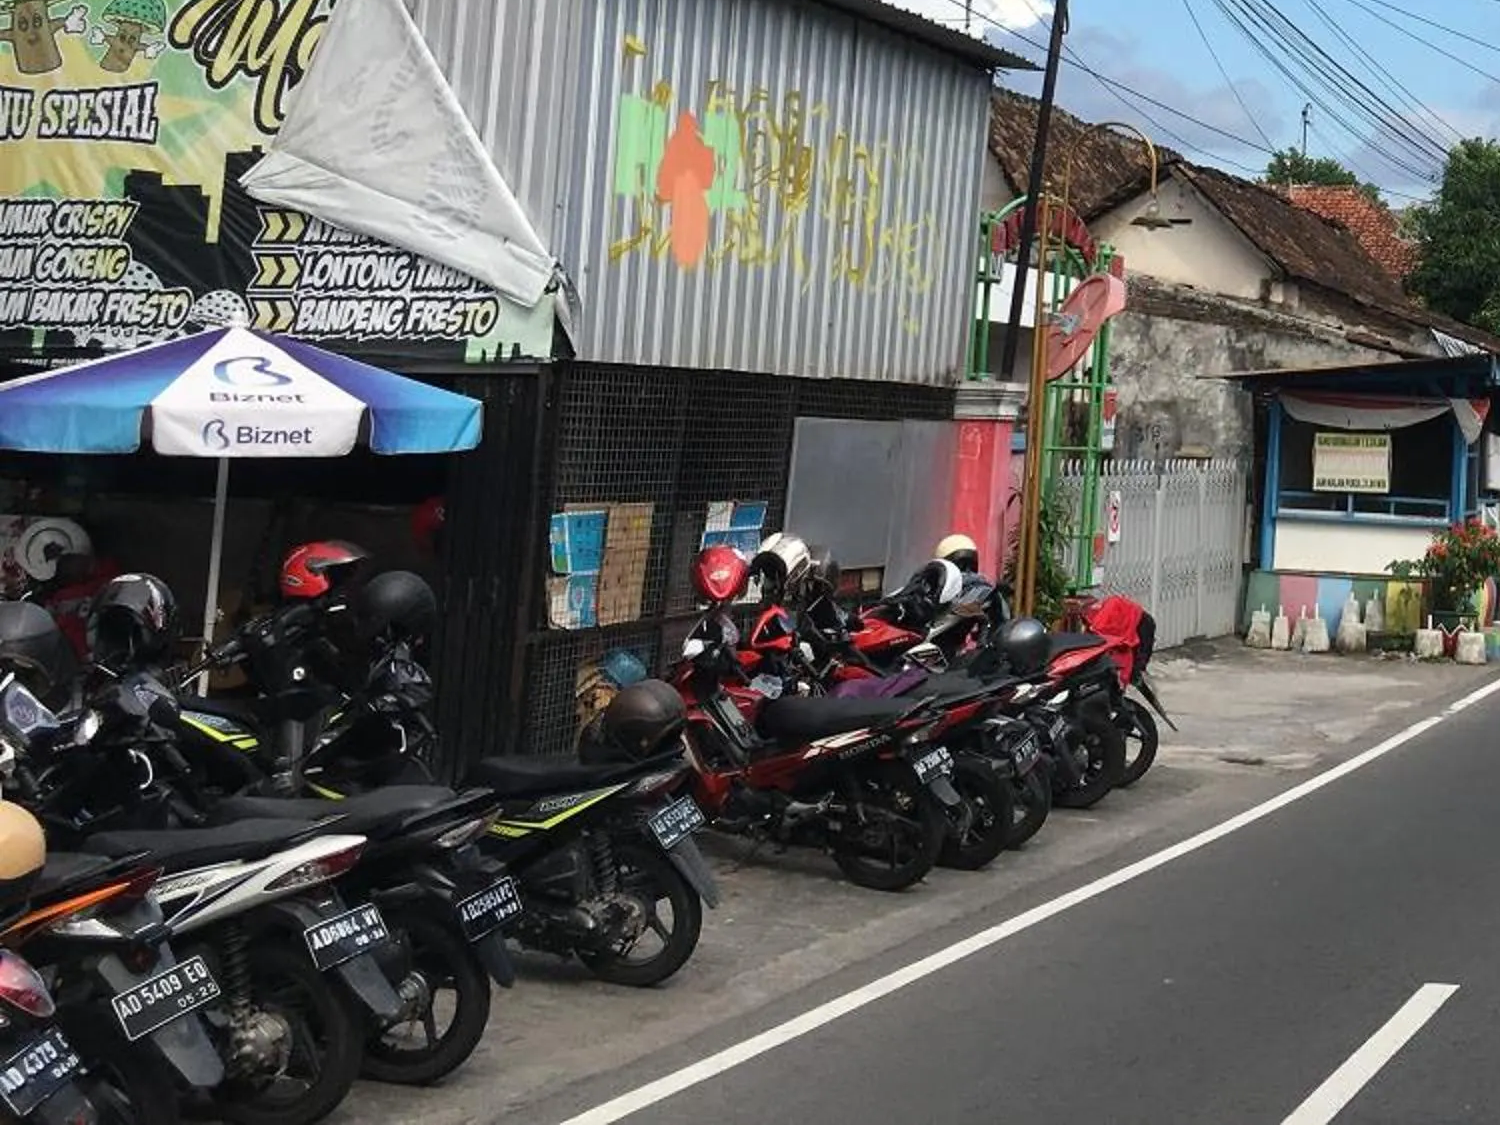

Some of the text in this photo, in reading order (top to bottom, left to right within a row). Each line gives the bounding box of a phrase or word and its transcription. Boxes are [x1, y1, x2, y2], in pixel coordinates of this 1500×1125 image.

[39, 84, 158, 143] SPESIAL
[53, 203, 133, 237] CRISPY
[36, 246, 126, 281] GORENG
[302, 253, 410, 288] LONTONG
[28, 290, 100, 322] BAKAR
[103, 290, 190, 327] FRESTO
[295, 299, 498, 336] BANDENG FRESTO
[209, 392, 304, 403] Biznet
[236, 426, 313, 444] Biznet
[119, 994, 143, 1019] AD
[140, 974, 182, 1005] 5409
